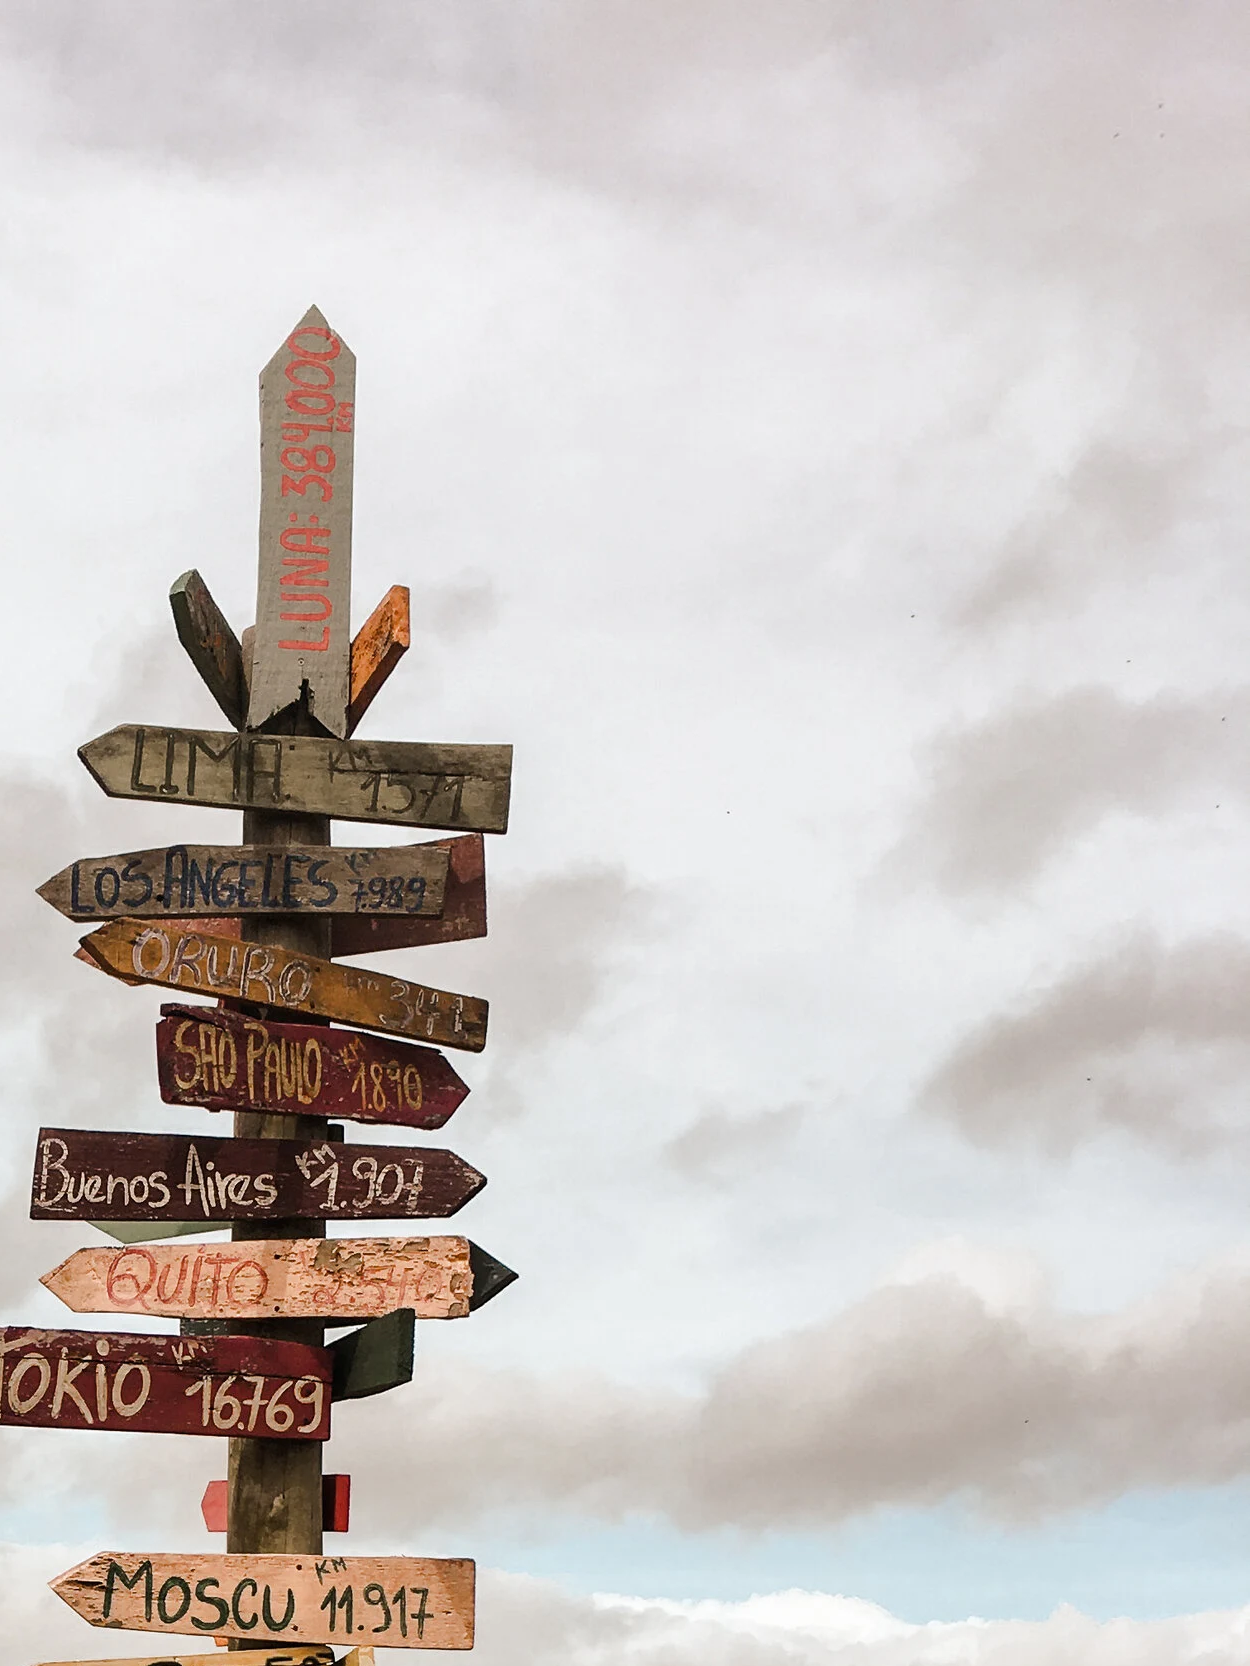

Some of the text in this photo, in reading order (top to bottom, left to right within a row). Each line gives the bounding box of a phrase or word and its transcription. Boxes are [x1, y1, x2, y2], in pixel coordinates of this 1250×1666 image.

[279, 326, 341, 502] 384.000
[278, 512, 333, 652] LUNA:
[33, 1137, 171, 1214] Buenos
[176, 1143, 279, 1217] Aires
[295, 1143, 337, 1180] KM
[184, 1374, 324, 1434] 16.769
[314, 1556, 348, 1585] KM
[320, 1582, 435, 1640] 11.917
